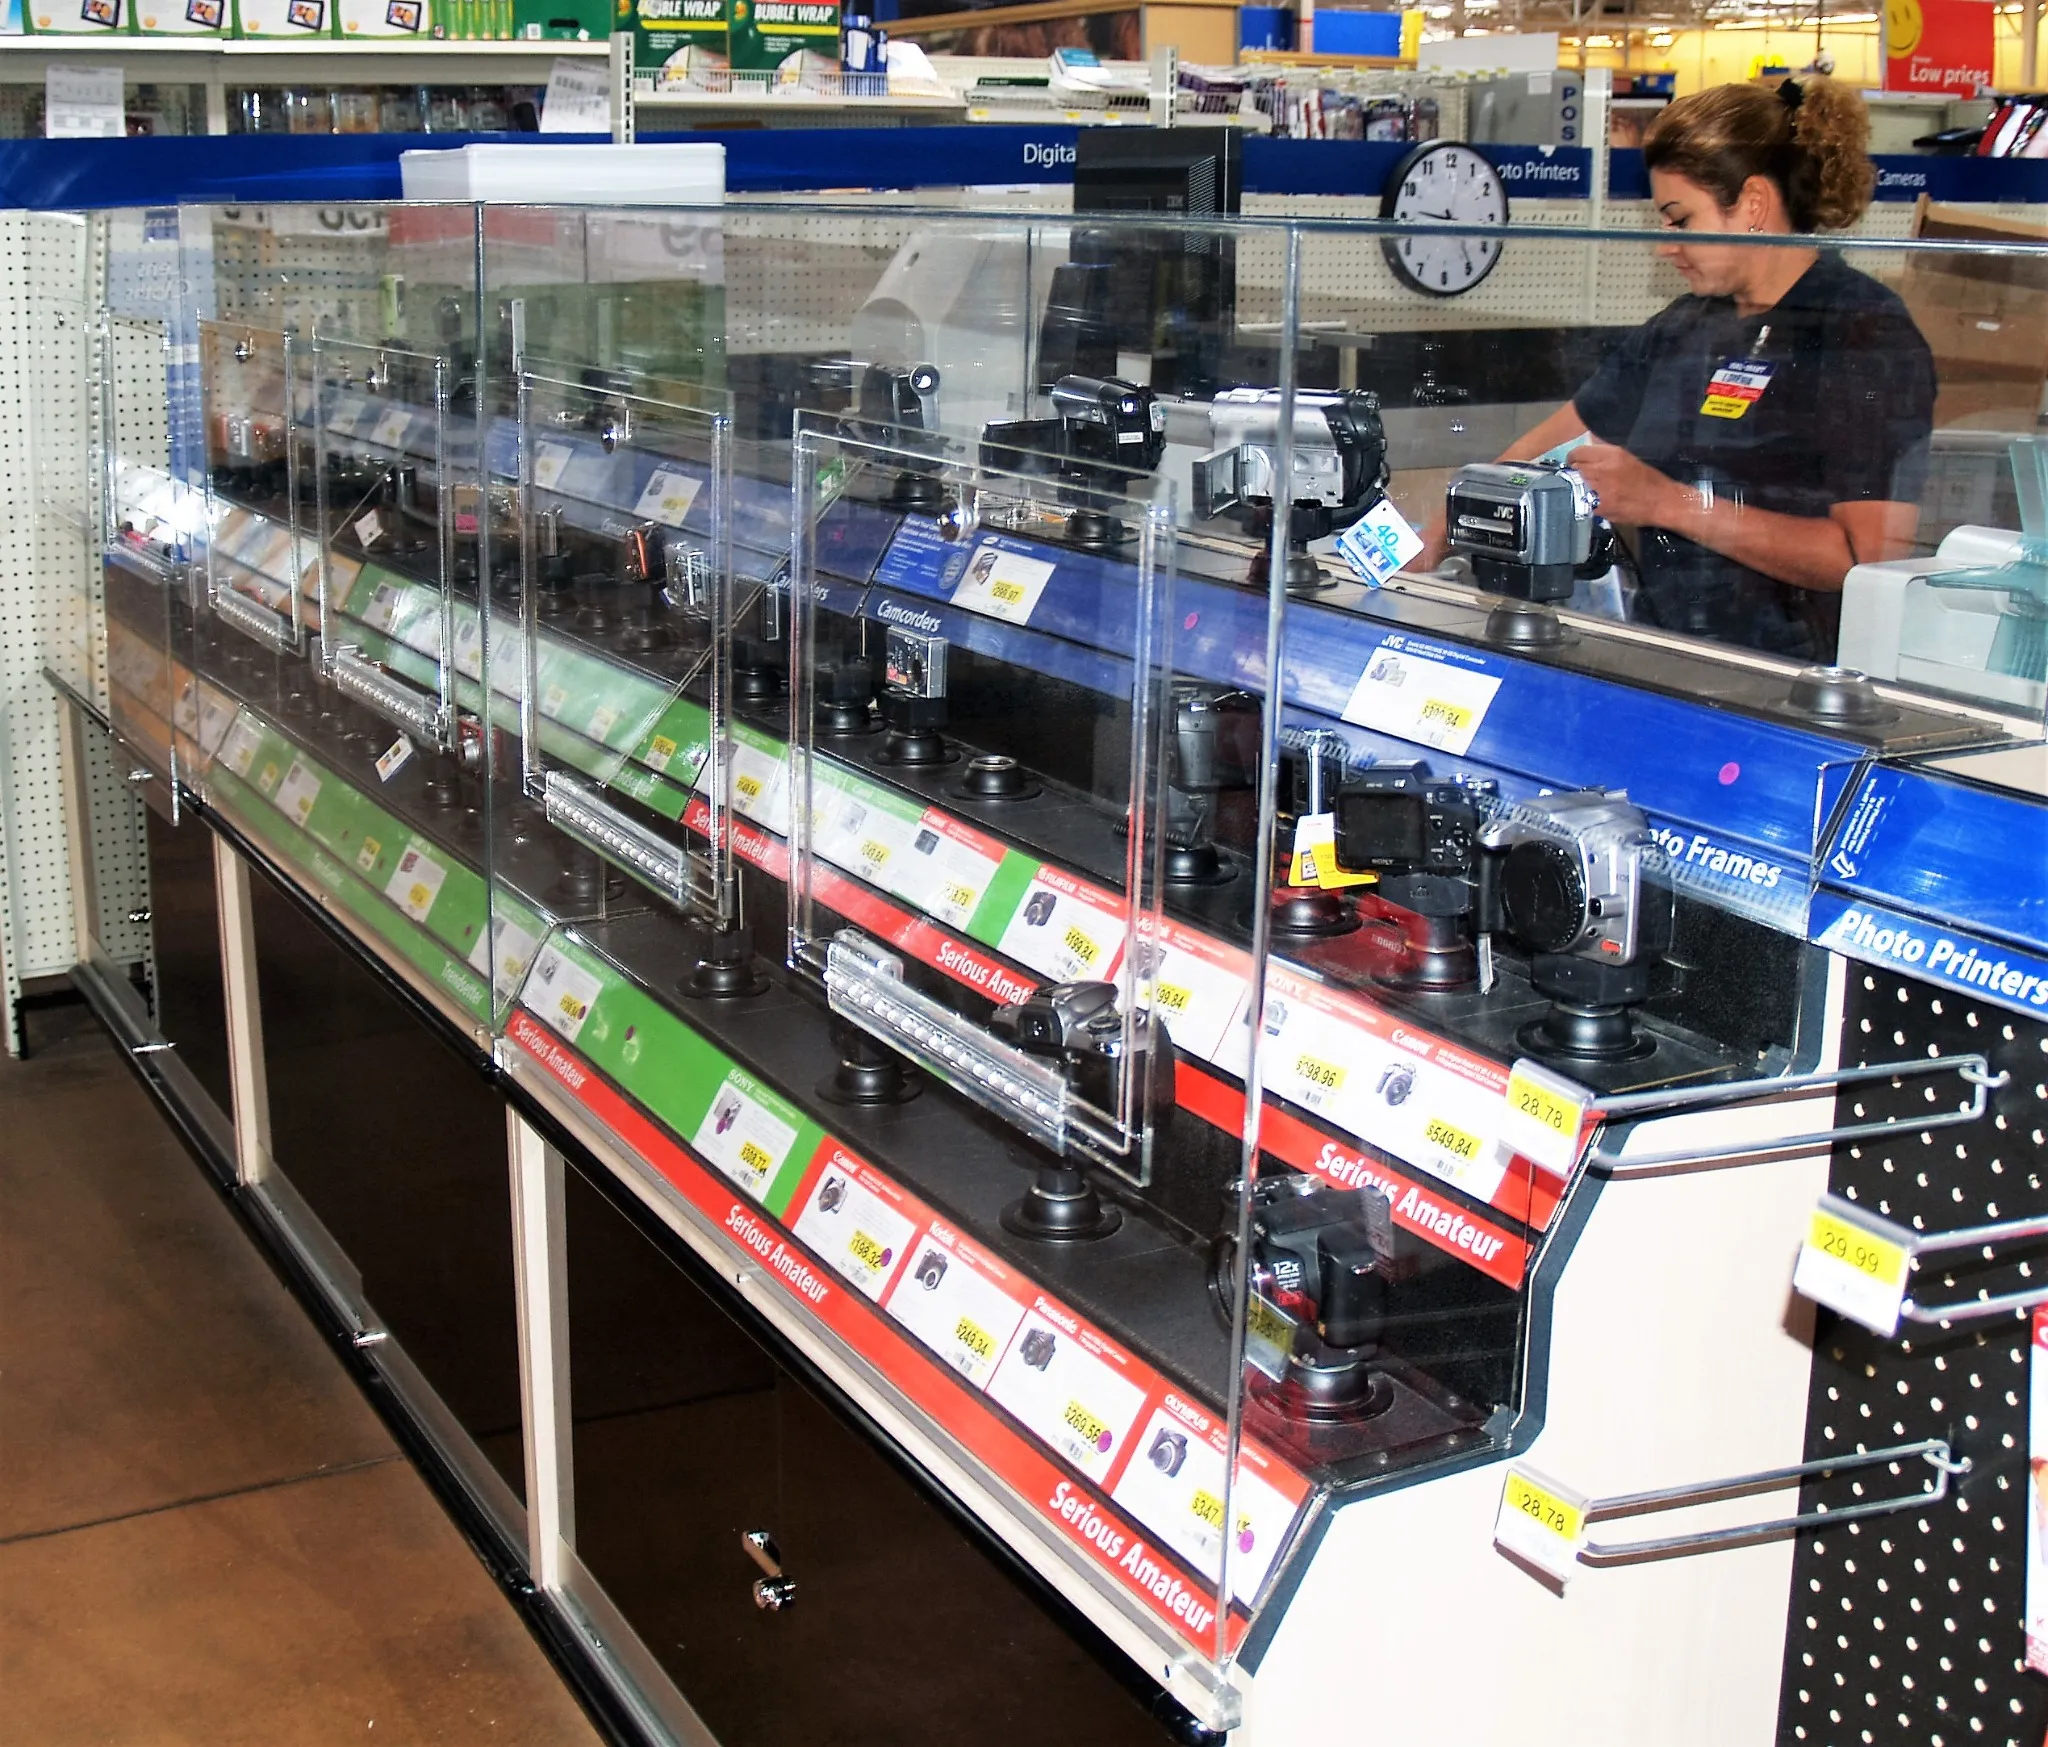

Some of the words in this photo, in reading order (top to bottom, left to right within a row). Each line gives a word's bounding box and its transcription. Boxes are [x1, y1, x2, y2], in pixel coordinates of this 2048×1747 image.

[684, 1, 721, 17] WRAP
[754, 3, 796, 20] BUBBLE
[798, 6, 835, 22] WRAP
[1910, 63, 1942, 82] Low
[1943, 64, 1989, 88] prices
[1423, 161, 1433, 175] 11
[1446, 153, 1457, 168] 12
[1525, 161, 1580, 182] Printers
[1404, 182, 1416, 196] 10
[1493, 505, 1513, 520] JVC
[877, 600, 941, 634] Camcorders
[1381, 634, 1405, 649] JVC
[1684, 834, 1781, 889] Frames
[1064, 932, 1094, 961] $199.84
[1836, 908, 1927, 964] Photo
[1925, 940, 2048, 1003] Printers
[935, 941, 987, 984] Serious
[514, 1018, 547, 1058] Serious
[547, 1045, 587, 1091] Amateur
[1391, 1028, 1434, 1056] Canon
[727, 1067, 754, 1093] SONY
[1426, 1122, 1474, 1157] $549.84
[832, 1150, 859, 1175] Canon
[1315, 1142, 1400, 1205] Serious
[1396, 1187, 1503, 1262] Amateur
[928, 1220, 957, 1248] Kodak
[725, 1204, 774, 1258] Serious
[768, 1243, 829, 1304] Amateur
[1823, 1231, 1879, 1273] 29.99
[1273, 1261, 1300, 1276] 12x
[1034, 1296, 1079, 1335] Panasonic
[956, 1322, 988, 1357] $249.34
[1064, 1404, 1098, 1444] $269.56
[1164, 1393, 1209, 1432] OLYMPUS
[1049, 1481, 1125, 1558] Serious
[1119, 1542, 1214, 1633] Amateur
